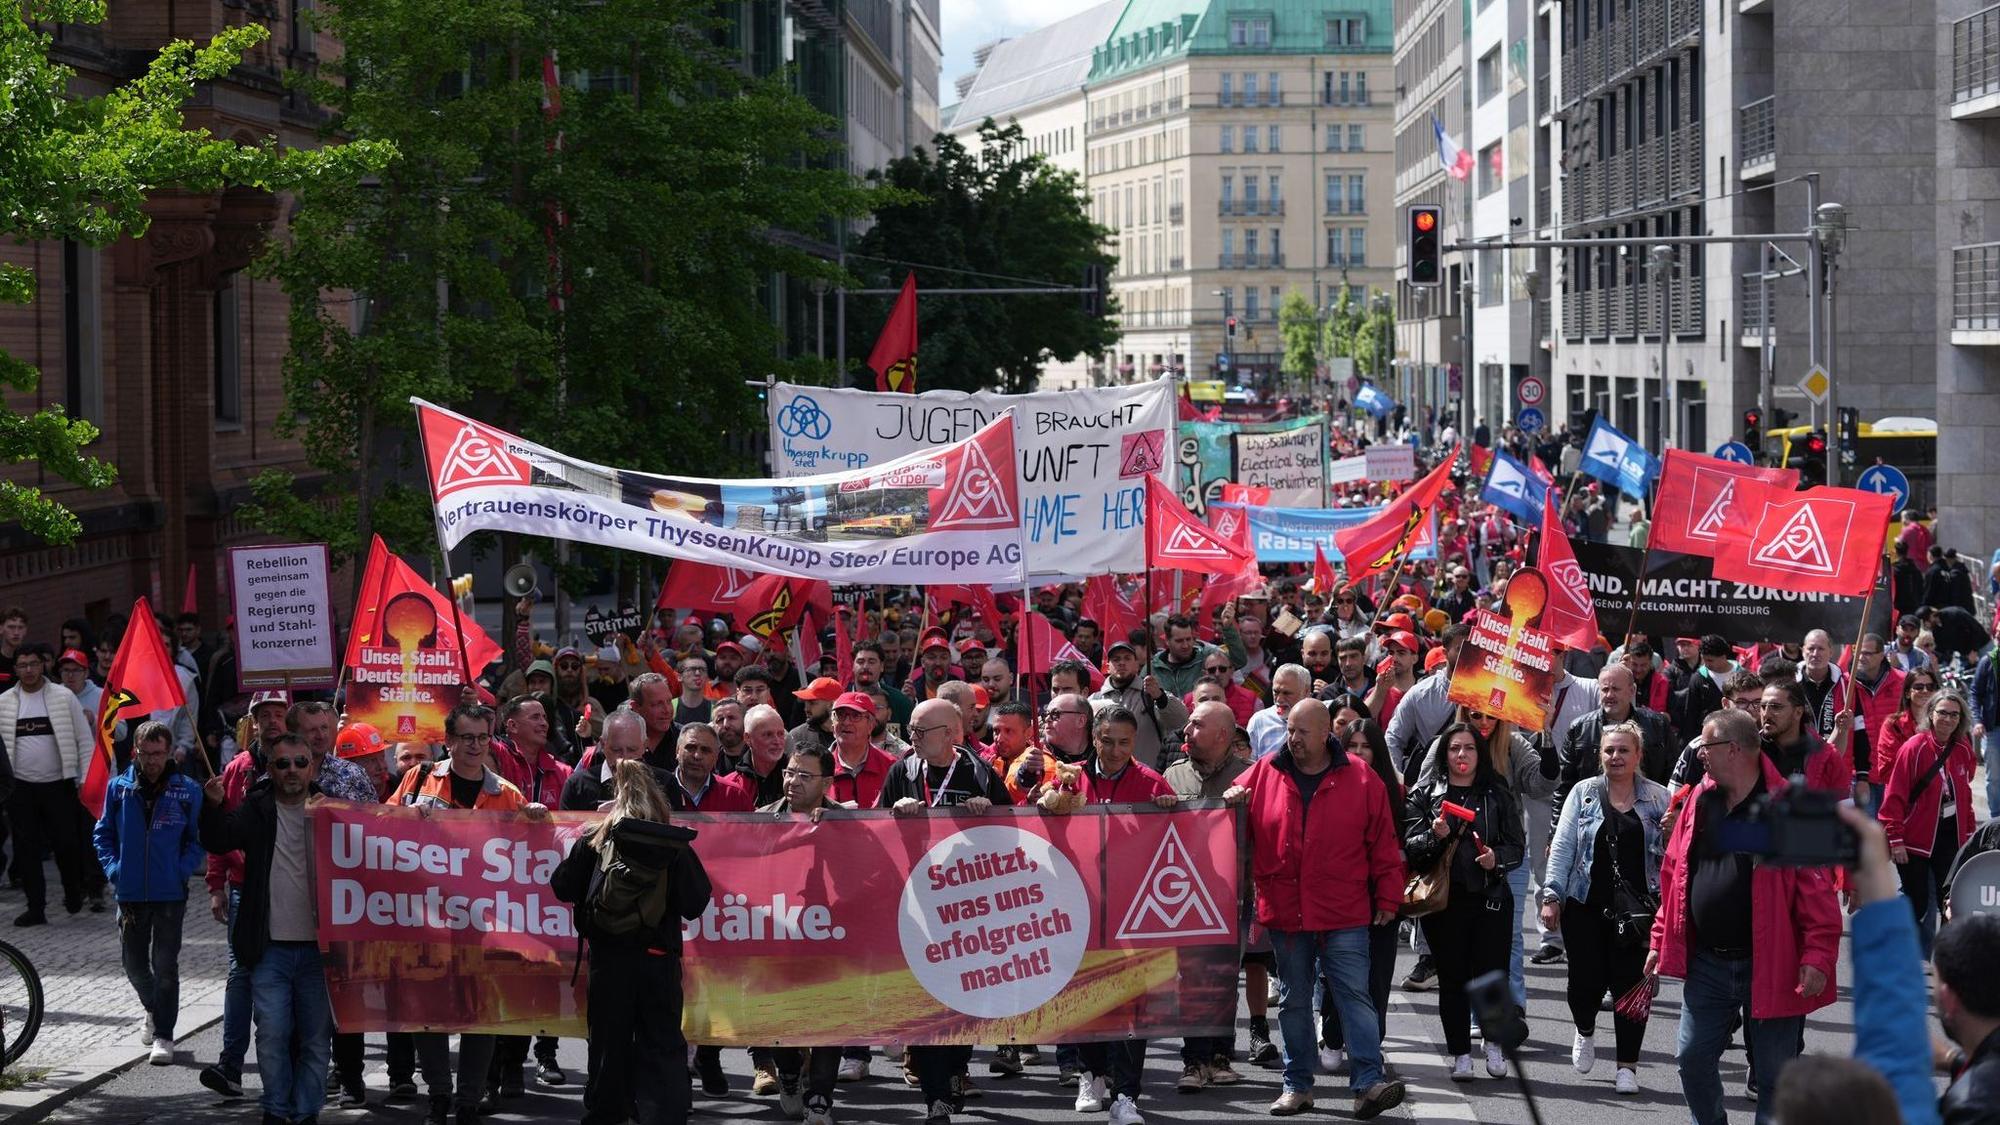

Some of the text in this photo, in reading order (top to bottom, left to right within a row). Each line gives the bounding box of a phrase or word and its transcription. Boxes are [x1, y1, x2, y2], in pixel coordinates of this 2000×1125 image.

[1524, 385, 1539, 397] 30
[876, 403, 1144, 444] JUGEN BRAUCHT
[1020, 444, 1110, 482] UNFT
[1240, 455, 1292, 472] Electrical
[1024, 493, 1081, 545] HME
[438, 499, 1021, 571] Vertrauenskörper ThyssenKrupp Steel Europe AG
[246, 556, 308, 570] Rebellion
[247, 572, 310, 586] gemeinsam
[1635, 578, 1727, 599] MACHT.
[254, 588, 306, 601] gegen die
[247, 603, 316, 618] Regierung
[1593, 599, 1770, 616] GEND ACELORMITTAL DUISBURG
[250, 619, 317, 633] und Stahl-
[1480, 612, 1550, 652] Unser Stahl.
[252, 636, 317, 649] konzerne!
[1470, 630, 1551, 672] Deutschlands
[362, 649, 455, 666] Unser Stahl.
[1482, 655, 1526, 684] Stärke.
[356, 667, 460, 685] Deutschlands
[379, 686, 435, 703] Stärke.
[331, 823, 574, 885] Unser Sta
[927, 845, 1039, 891] Schützt,
[331, 878, 578, 938] Deutschla
[936, 882, 1044, 925] was uns
[924, 908, 1073, 964] erfolgreich
[960, 947, 1051, 993] macht!
